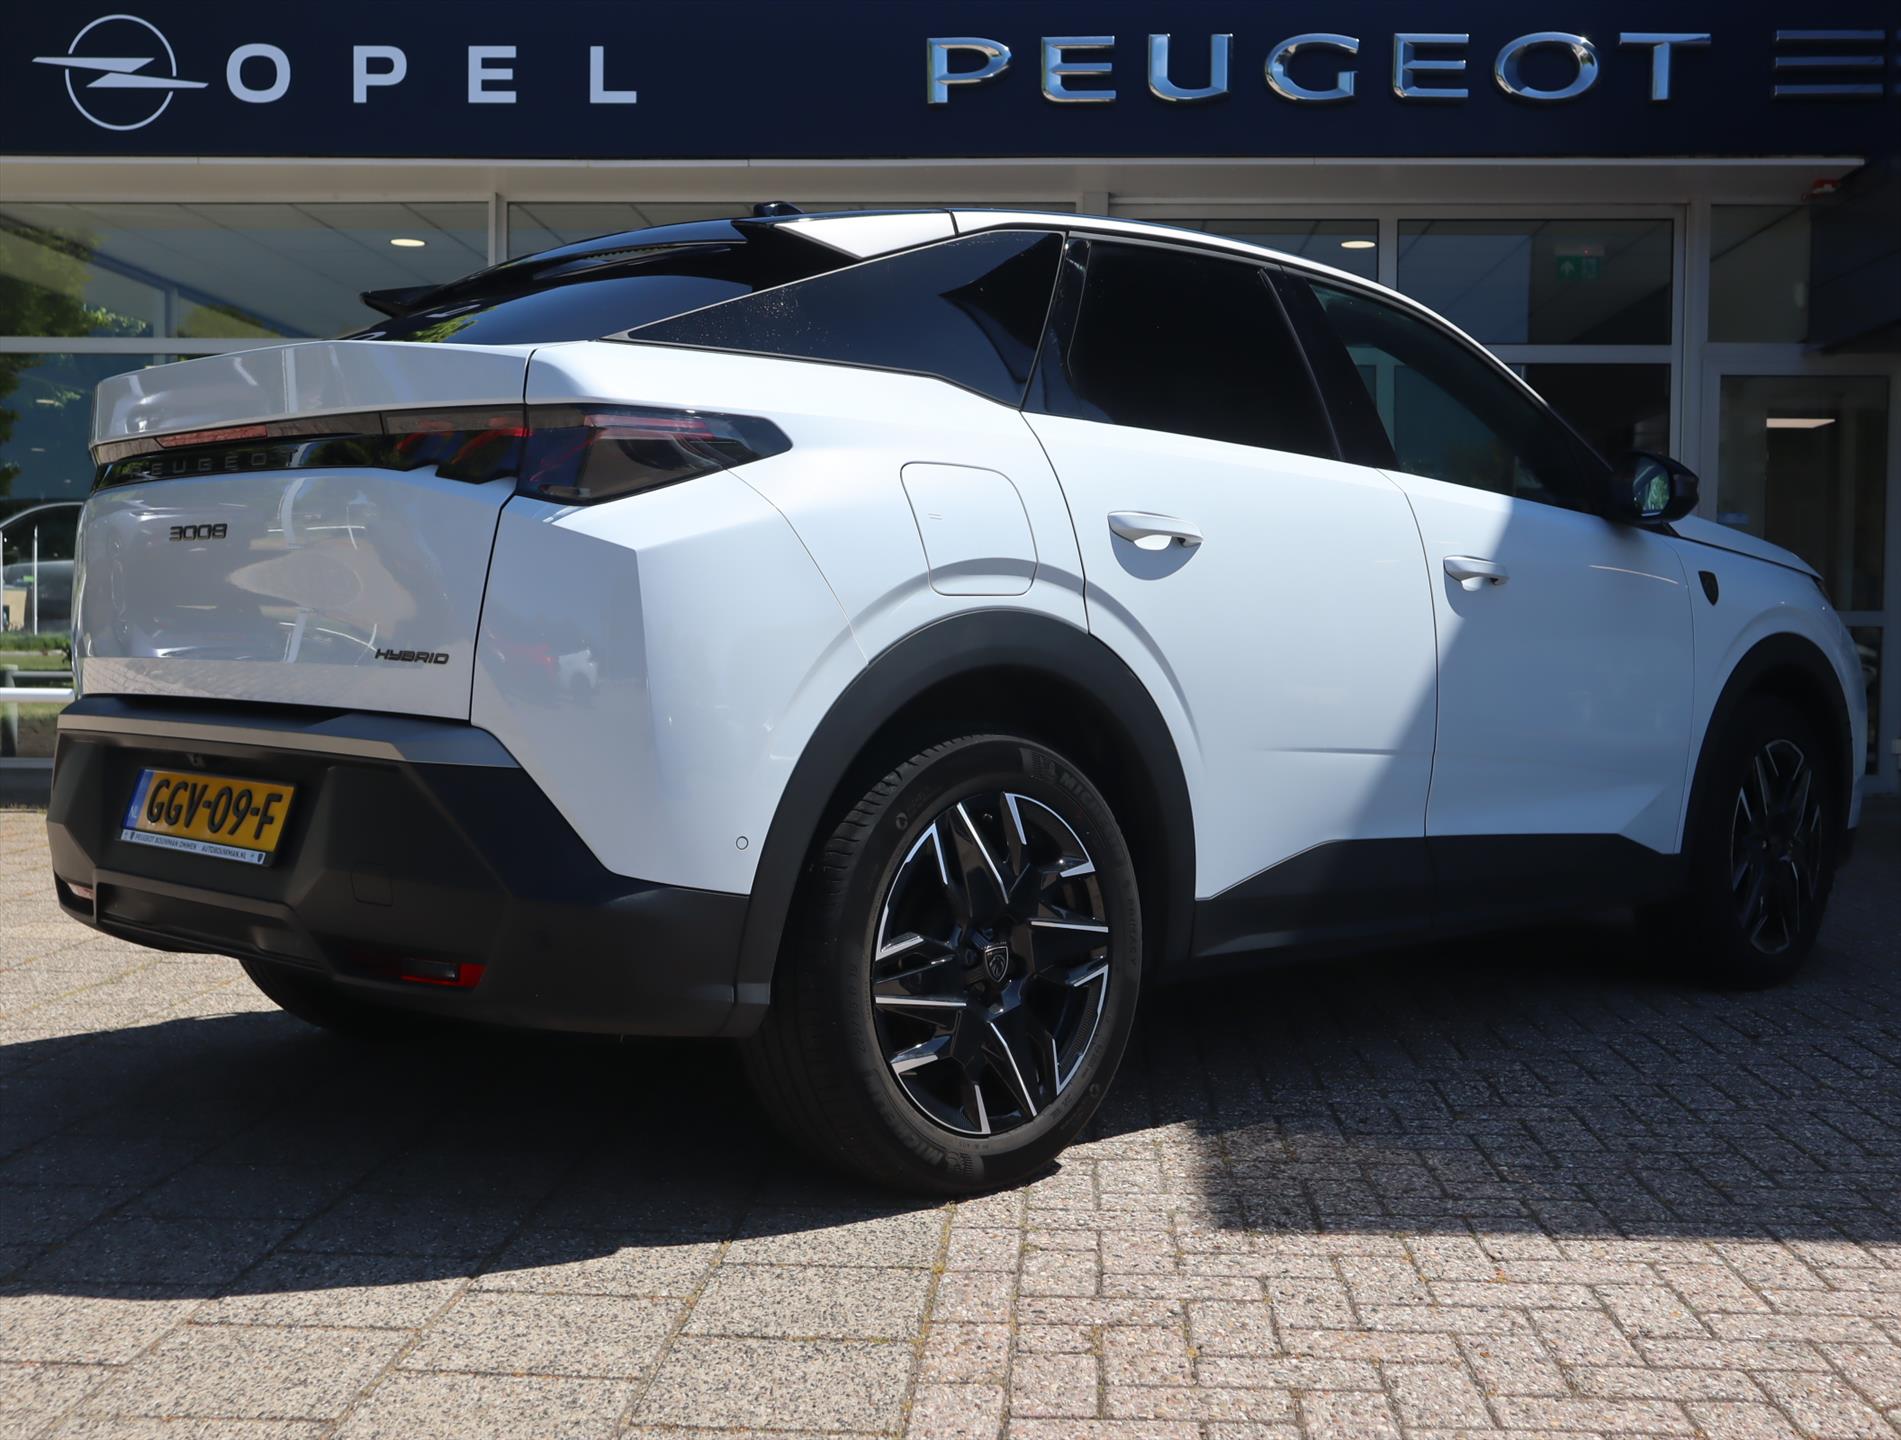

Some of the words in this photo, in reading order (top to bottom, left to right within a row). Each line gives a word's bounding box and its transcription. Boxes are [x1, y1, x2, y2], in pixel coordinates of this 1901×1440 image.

[226, 43, 637, 103] OPEL
[926, 32, 1711, 104] PEUGEOT
[169, 523, 228, 542] 3008
[375, 648, 450, 665] HYBRID
[146, 779, 283, 840] GGV-09-F
